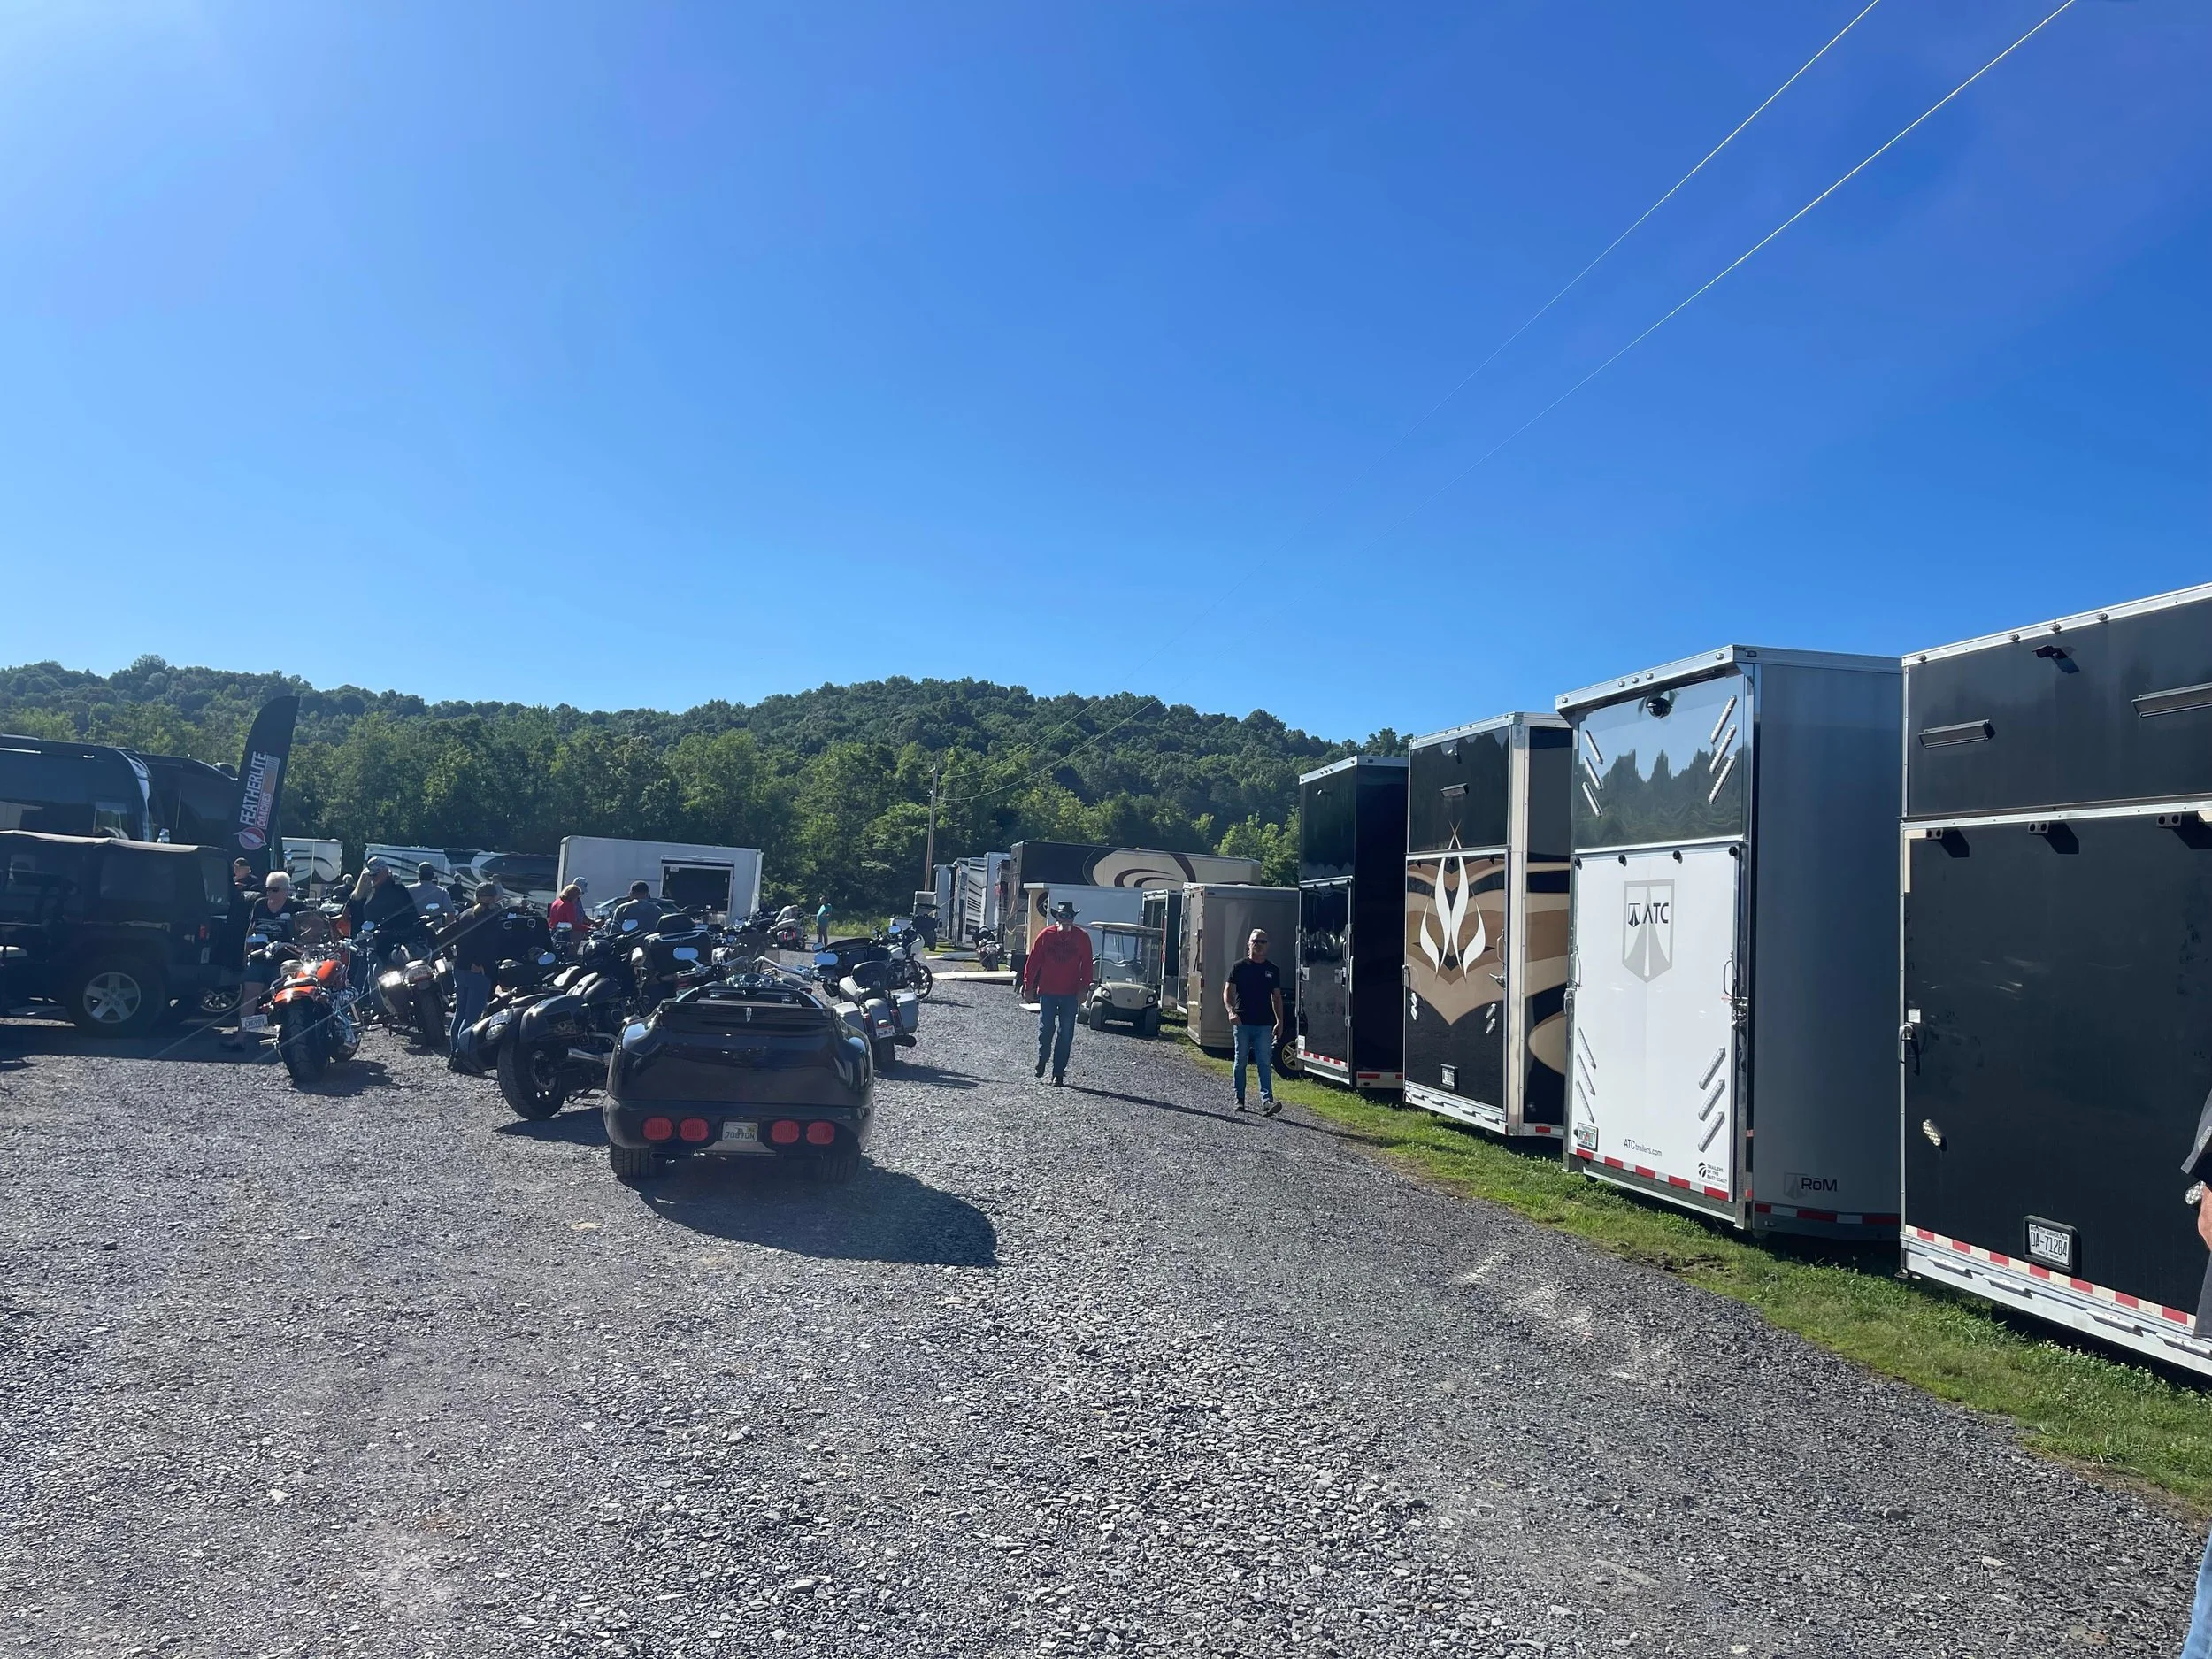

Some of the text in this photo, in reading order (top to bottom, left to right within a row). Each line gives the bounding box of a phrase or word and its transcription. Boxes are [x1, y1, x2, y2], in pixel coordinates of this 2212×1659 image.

[240, 751, 267, 826] FEATHERLITE
[257, 793, 272, 826] COACHES
[1642, 902, 1670, 924] ATC
